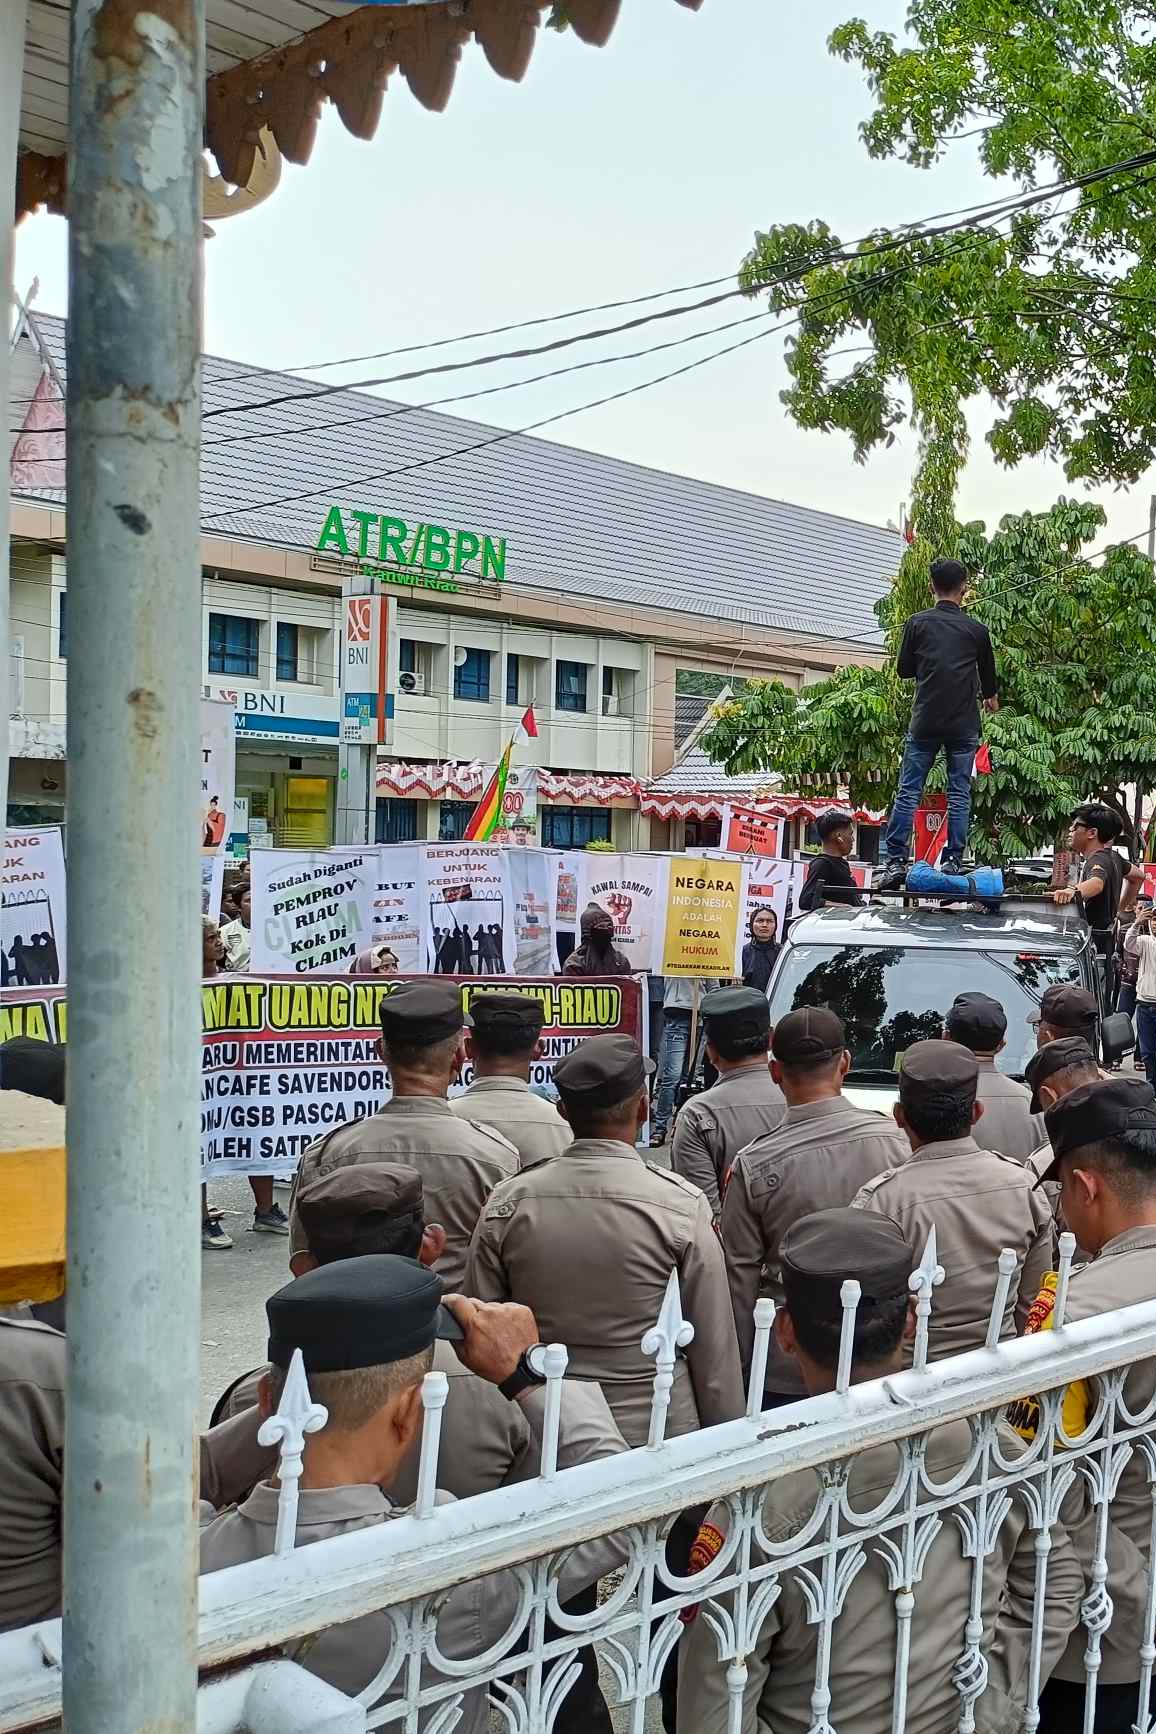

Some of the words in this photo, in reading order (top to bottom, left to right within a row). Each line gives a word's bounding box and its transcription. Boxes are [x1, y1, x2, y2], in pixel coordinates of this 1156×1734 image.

[316, 505, 507, 580] ATR/BPN
[348, 646, 368, 665] BNI
[244, 692, 286, 714] BNI
[426, 848, 500, 859] BERJUANG
[268, 871, 312, 893] Sudah
[313, 856, 364, 880] Diganti
[443, 863, 488, 873] UNTUK
[427, 876, 502, 886] KEBENARAN
[591, 880, 620, 897] KAWAL
[621, 880, 654, 898] SAMPAI
[675, 876, 735, 892] NEGARA
[272, 879, 358, 916] PEMPROV
[672, 895, 734, 910] INDONESIA
[295, 902, 340, 929] RIAU
[681, 911, 723, 923] ADALAH
[289, 932, 327, 954] Kok
[329, 925, 347, 943] Di
[679, 928, 721, 940] NEGARA
[295, 942, 357, 973] CLAIM
[681, 945, 719, 956] HUKUM
[270, 984, 348, 1028] UANG
[282, 1101, 347, 1126] PASCA
[207, 1137, 252, 1163] OLEH
[259, 1133, 325, 1159] SATP
